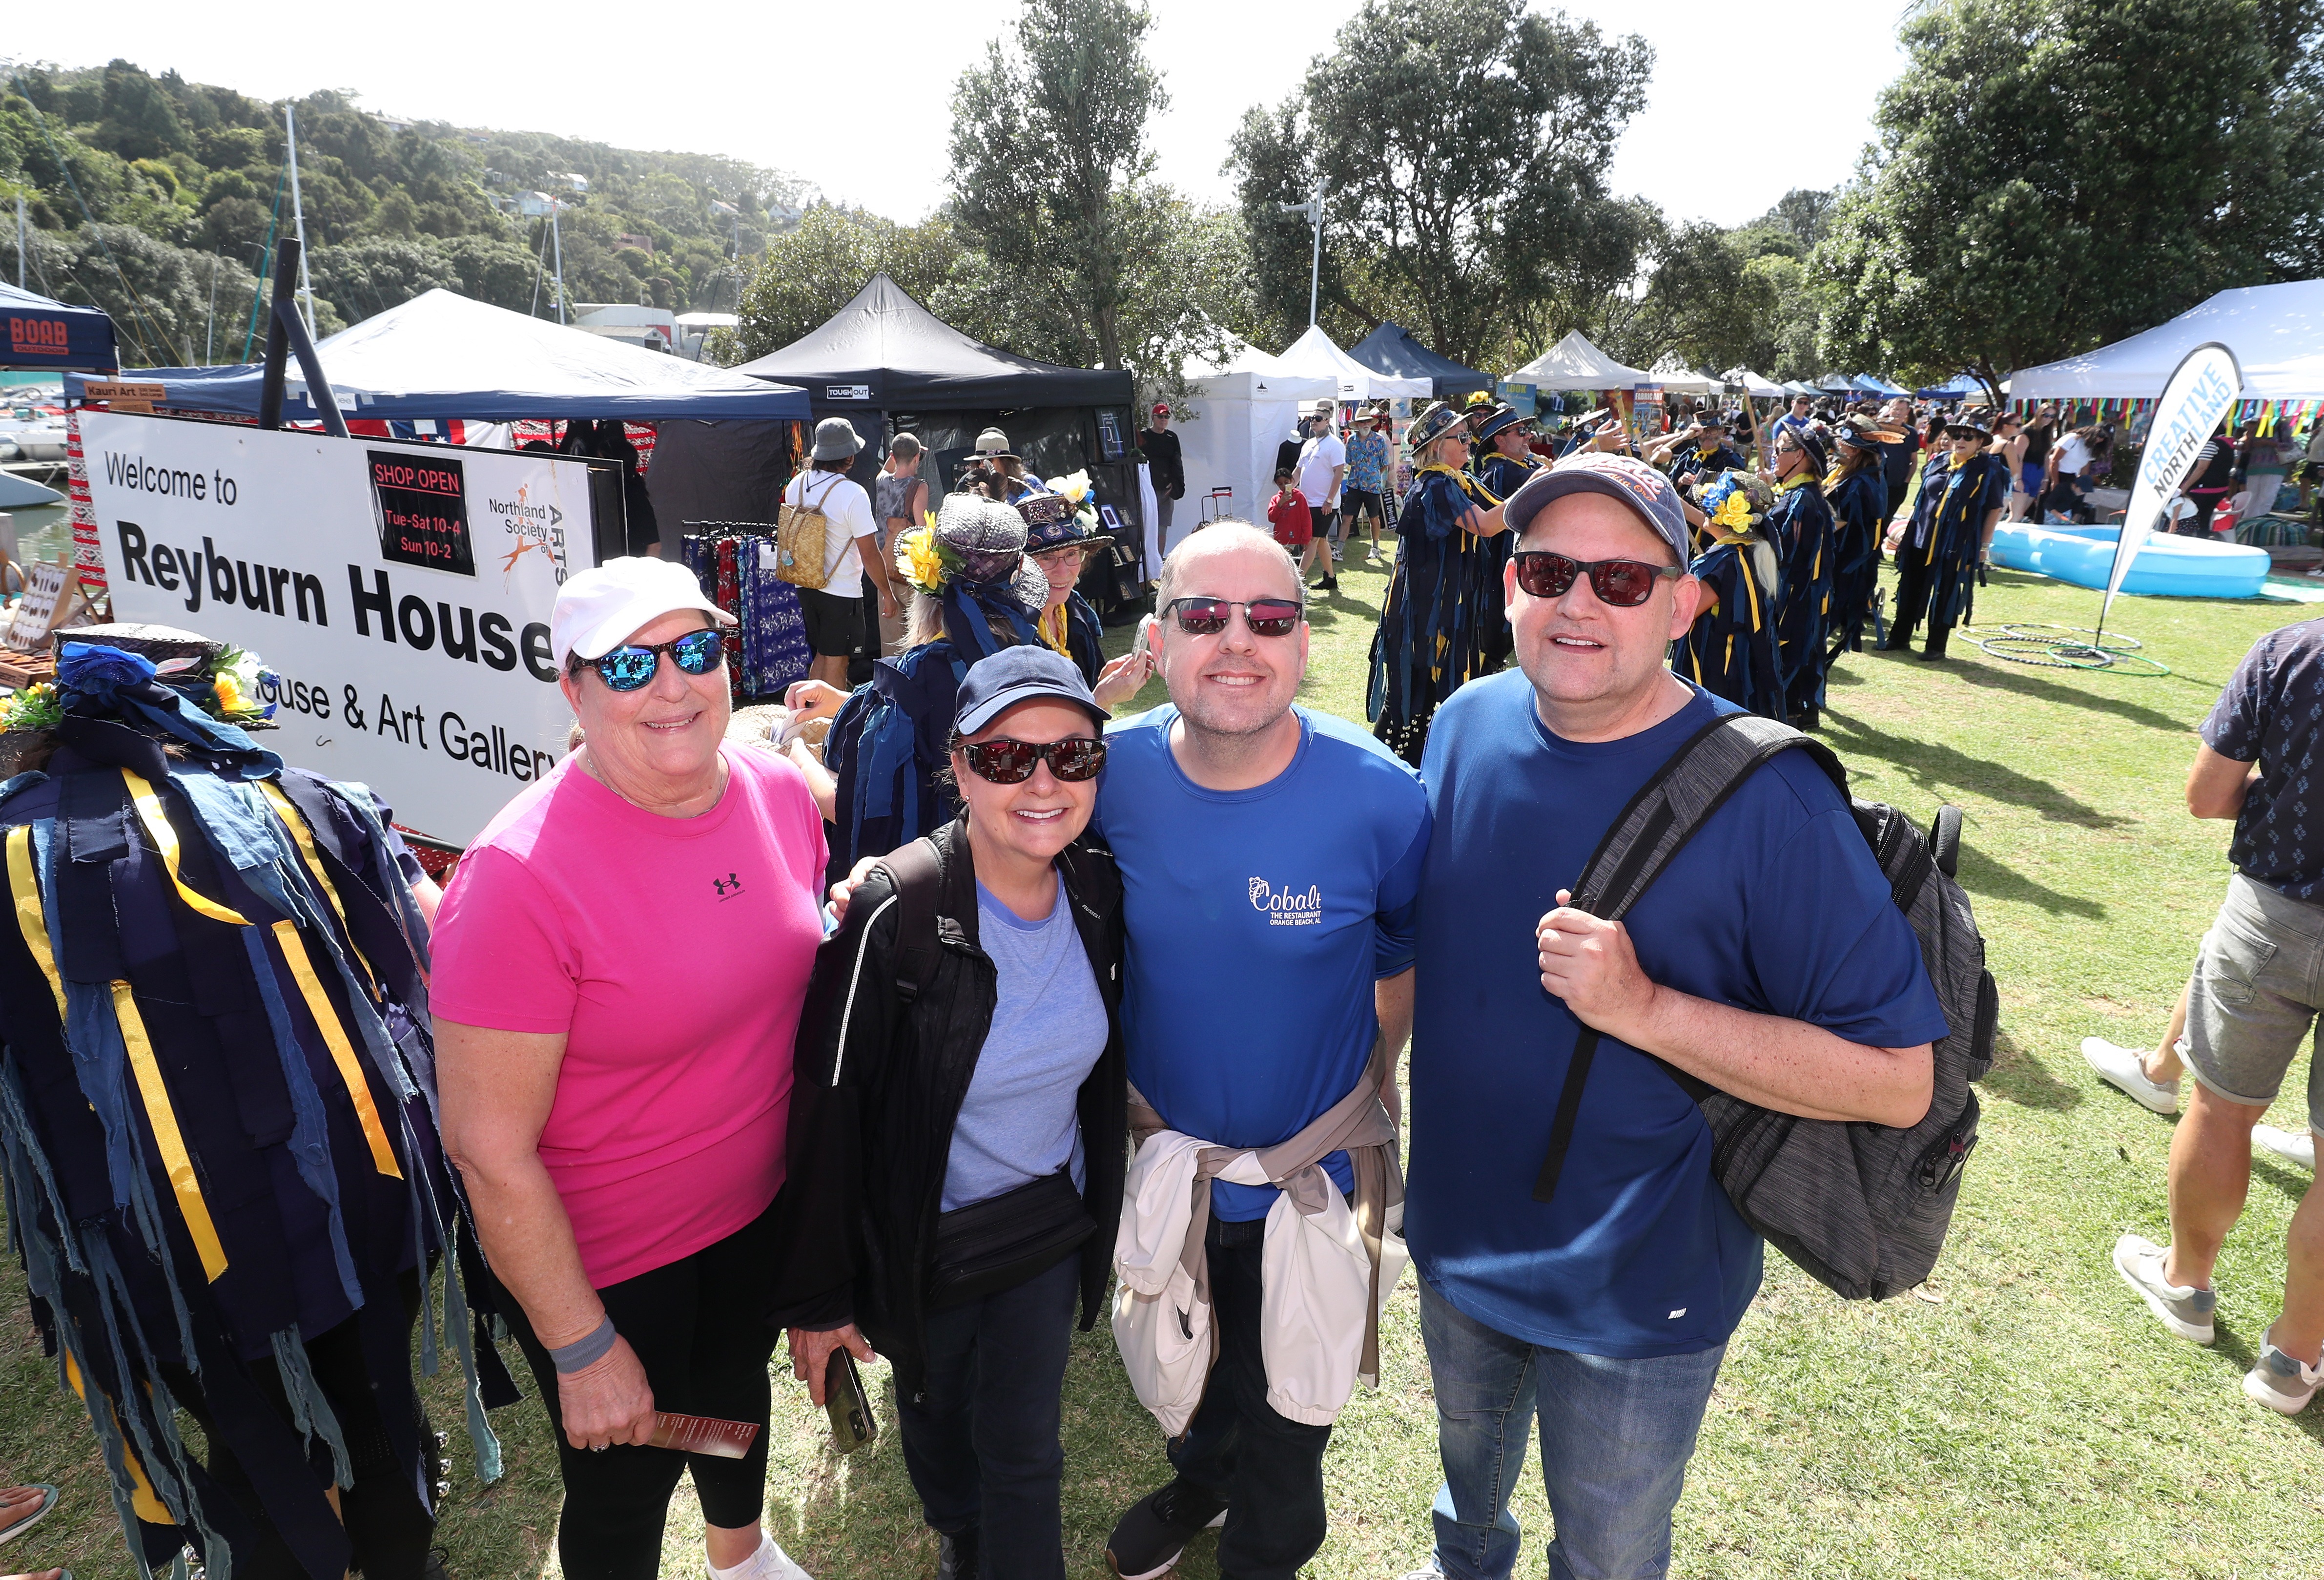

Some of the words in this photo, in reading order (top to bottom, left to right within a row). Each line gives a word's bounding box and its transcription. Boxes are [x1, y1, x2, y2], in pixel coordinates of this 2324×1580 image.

[10, 317, 68, 346] BOAB
[88, 387, 116, 395] Kauri
[120, 387, 136, 396] Art
[1506, 384, 1527, 394] LOOK
[2144, 361, 2222, 484] CREATIVE
[2153, 381, 2232, 499] NORTHLAND
[104, 450, 206, 500] Welcome
[214, 469, 237, 505] to
[375, 464, 414, 485] SHOP
[417, 469, 459, 492] OPEN
[386, 510, 430, 530] Tue-Sat
[433, 517, 461, 535] 10-4
[489, 499, 546, 520] Northland
[505, 519, 547, 542] Society
[401, 537, 422, 554] Sun
[424, 541, 452, 559] 10-2
[541, 545, 549, 553] of
[549, 504, 568, 586] ARTS
[116, 520, 328, 627] Reyburn
[348, 564, 559, 682] House
[344, 684, 367, 731] &
[378, 693, 428, 750] Art
[439, 712, 555, 781] Galler
[1250, 879, 1321, 911] Cobalt
[1284, 911, 1321, 919] RESTAURANT
